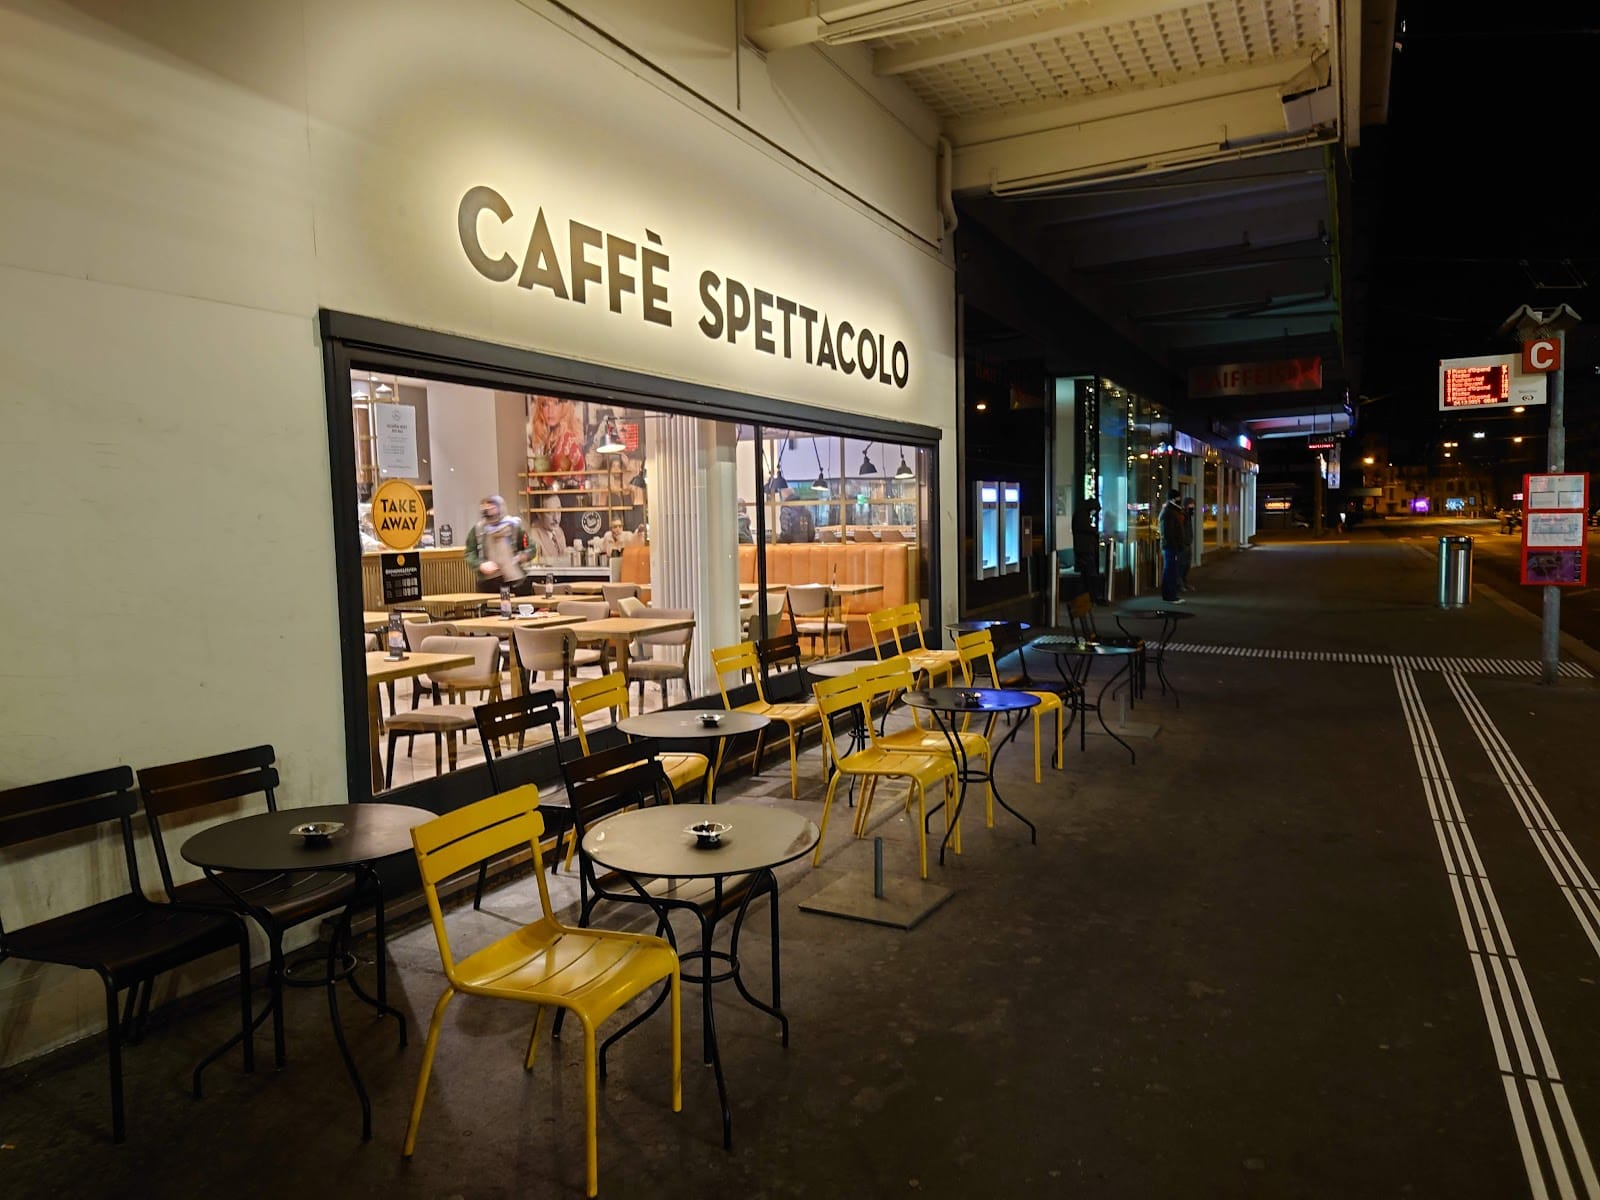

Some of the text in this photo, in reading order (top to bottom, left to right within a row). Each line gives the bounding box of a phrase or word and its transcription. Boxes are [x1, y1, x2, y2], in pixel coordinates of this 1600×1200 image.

[457, 185, 910, 390] CAFFÈ SPETTACOLO
[1530, 341, 1554, 369] C
[380, 499, 417, 513] TAKE
[380, 516, 418, 531] AWAY
